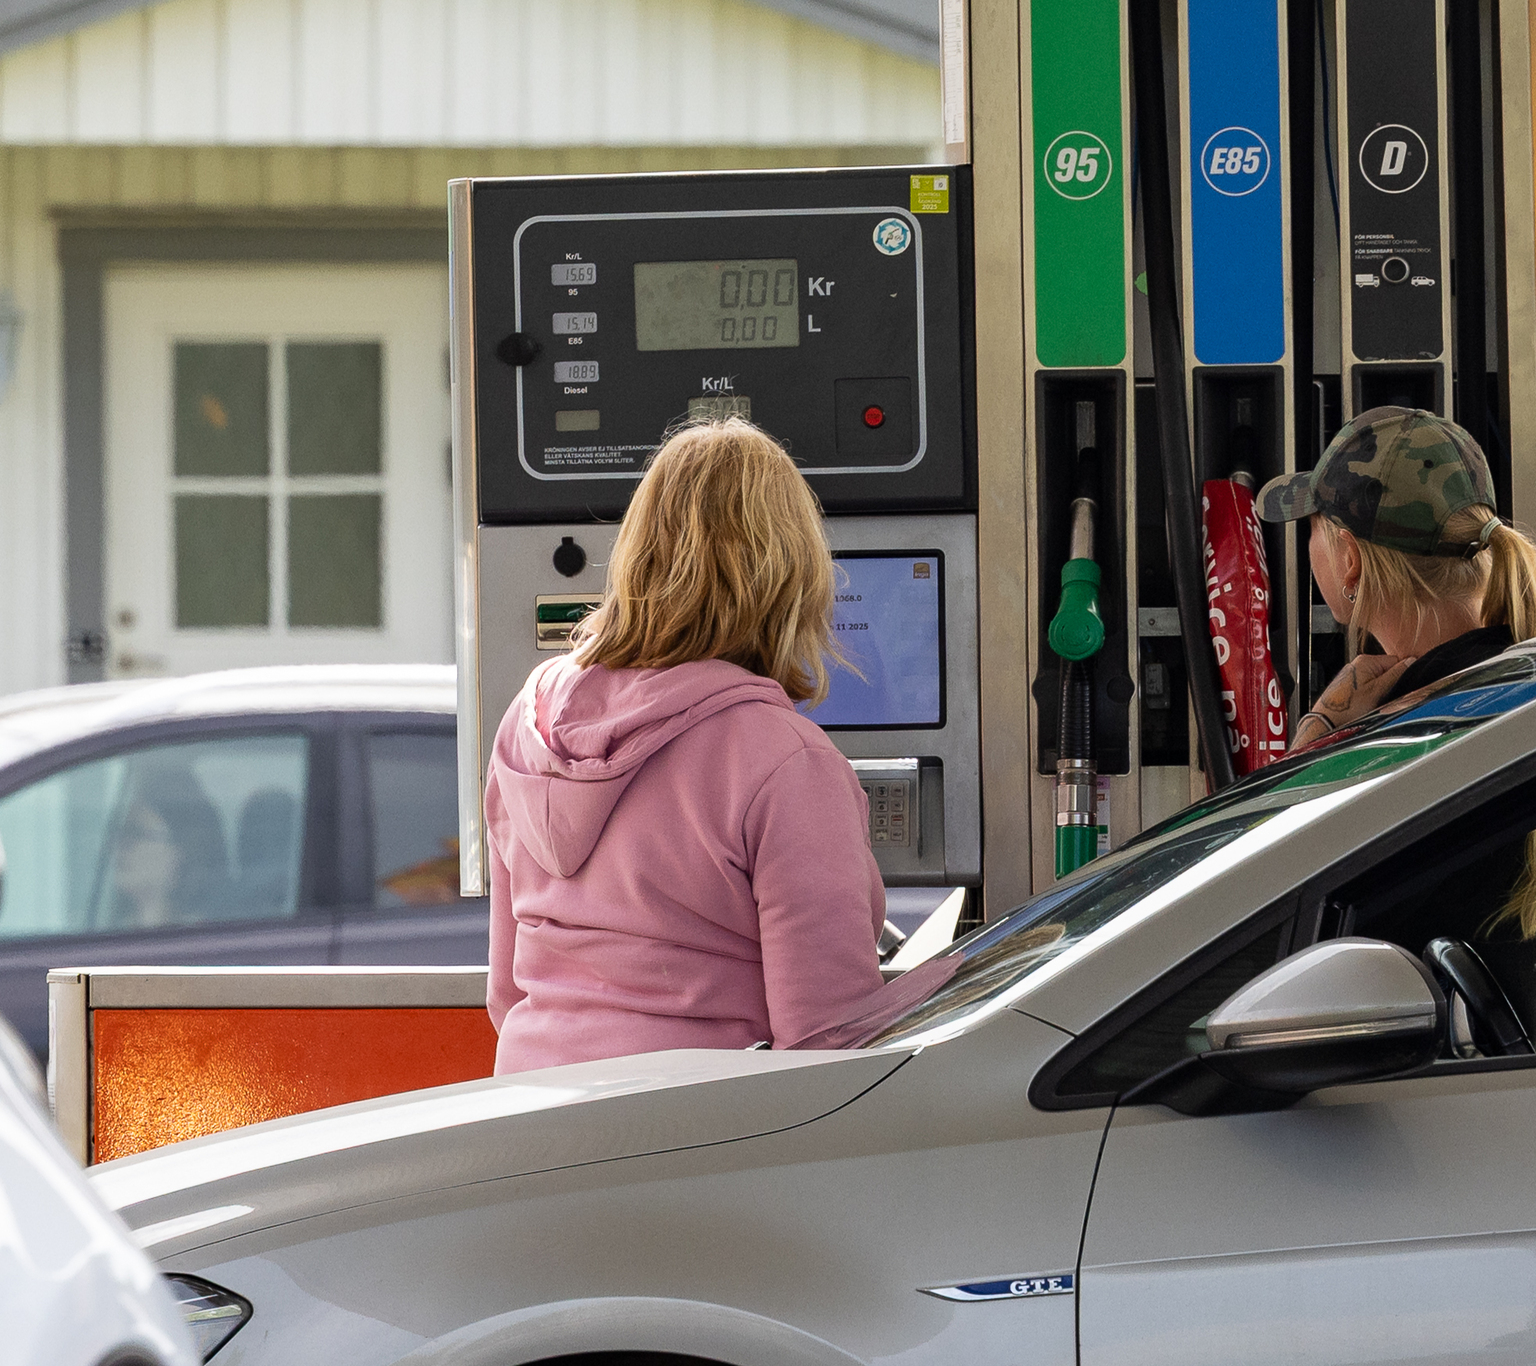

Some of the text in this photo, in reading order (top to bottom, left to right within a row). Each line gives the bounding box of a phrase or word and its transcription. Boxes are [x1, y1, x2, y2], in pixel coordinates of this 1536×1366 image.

[1054, 147, 1100, 183] 95
[1209, 146, 1262, 175] E85
[1379, 141, 1408, 175] D
[568, 288, 578, 296] 95
[808, 277, 835, 296] Kr
[807, 314, 821, 332] L
[568, 337, 583, 345] E85
[564, 386, 588, 394] Diesel
[702, 376, 734, 390] Kr/L
[1009, 1277, 1063, 1296] GTE
